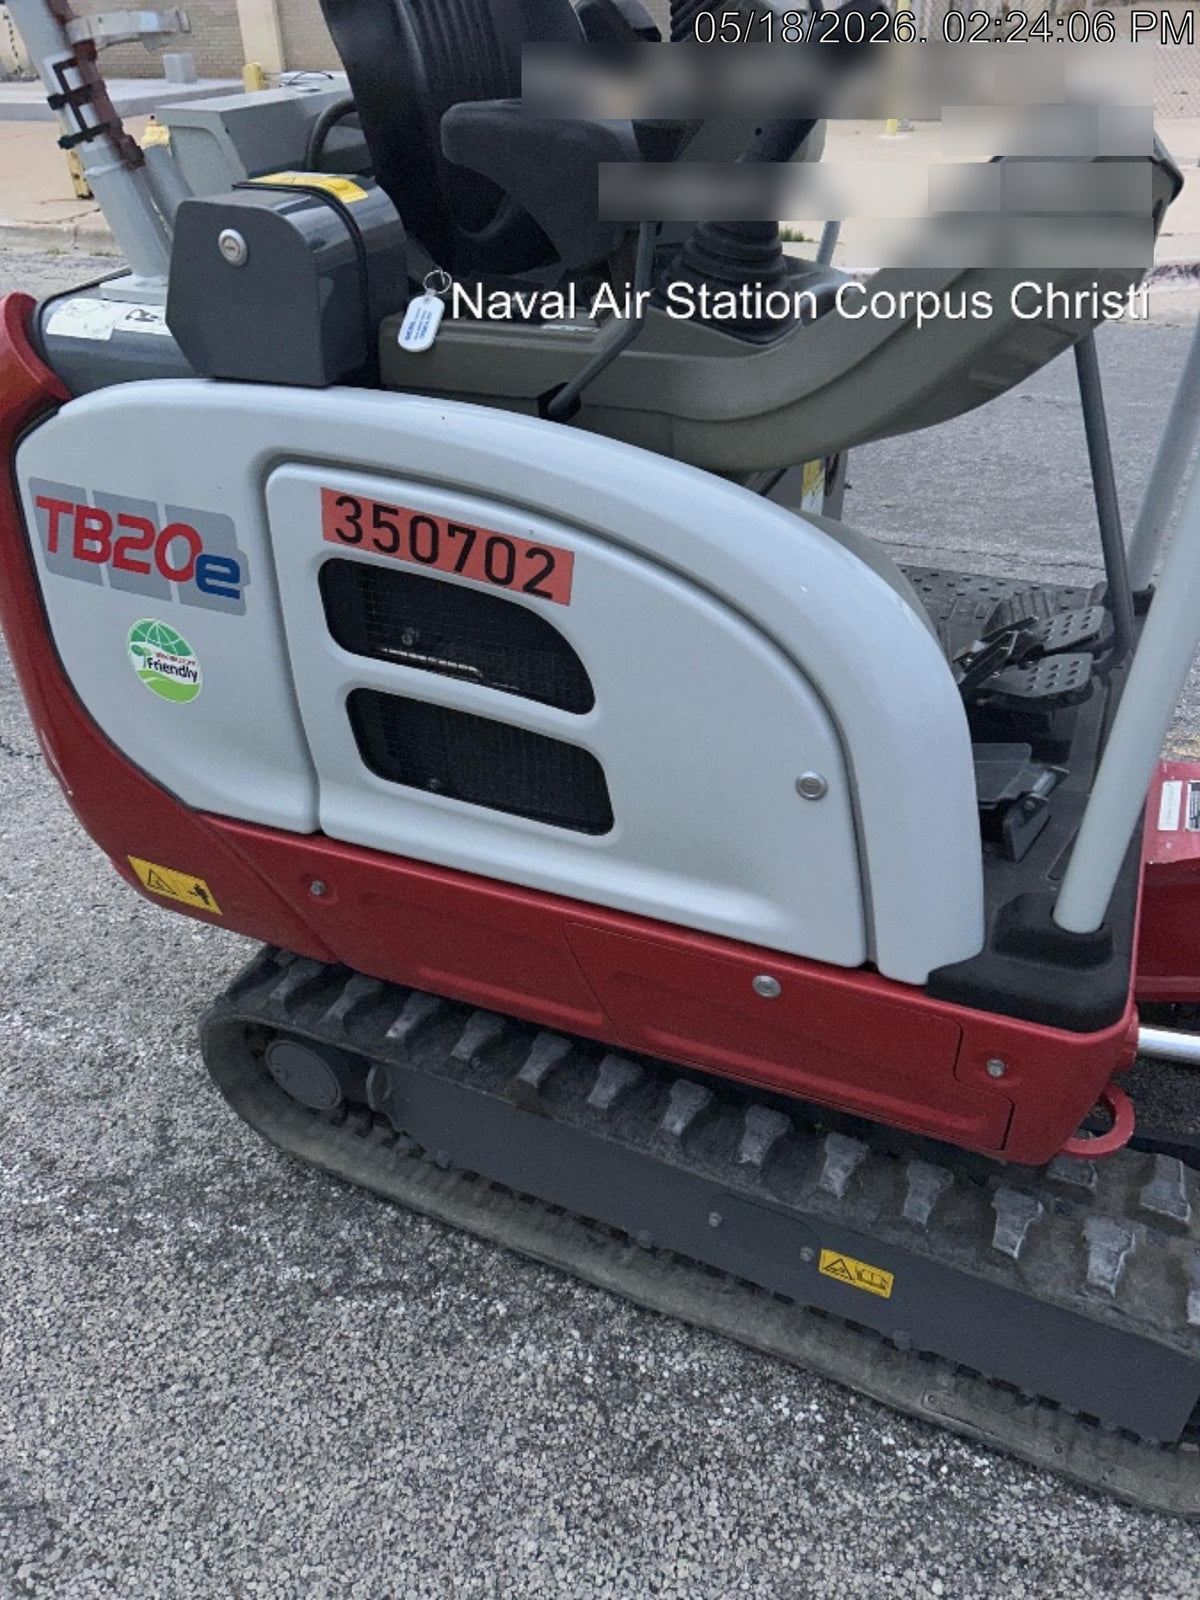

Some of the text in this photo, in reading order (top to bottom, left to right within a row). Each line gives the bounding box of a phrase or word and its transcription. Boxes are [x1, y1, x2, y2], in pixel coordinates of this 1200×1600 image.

[35, 495, 241, 600] TB20e
[334, 495, 556, 600] 350702
[147, 657, 198, 683] Friendly
